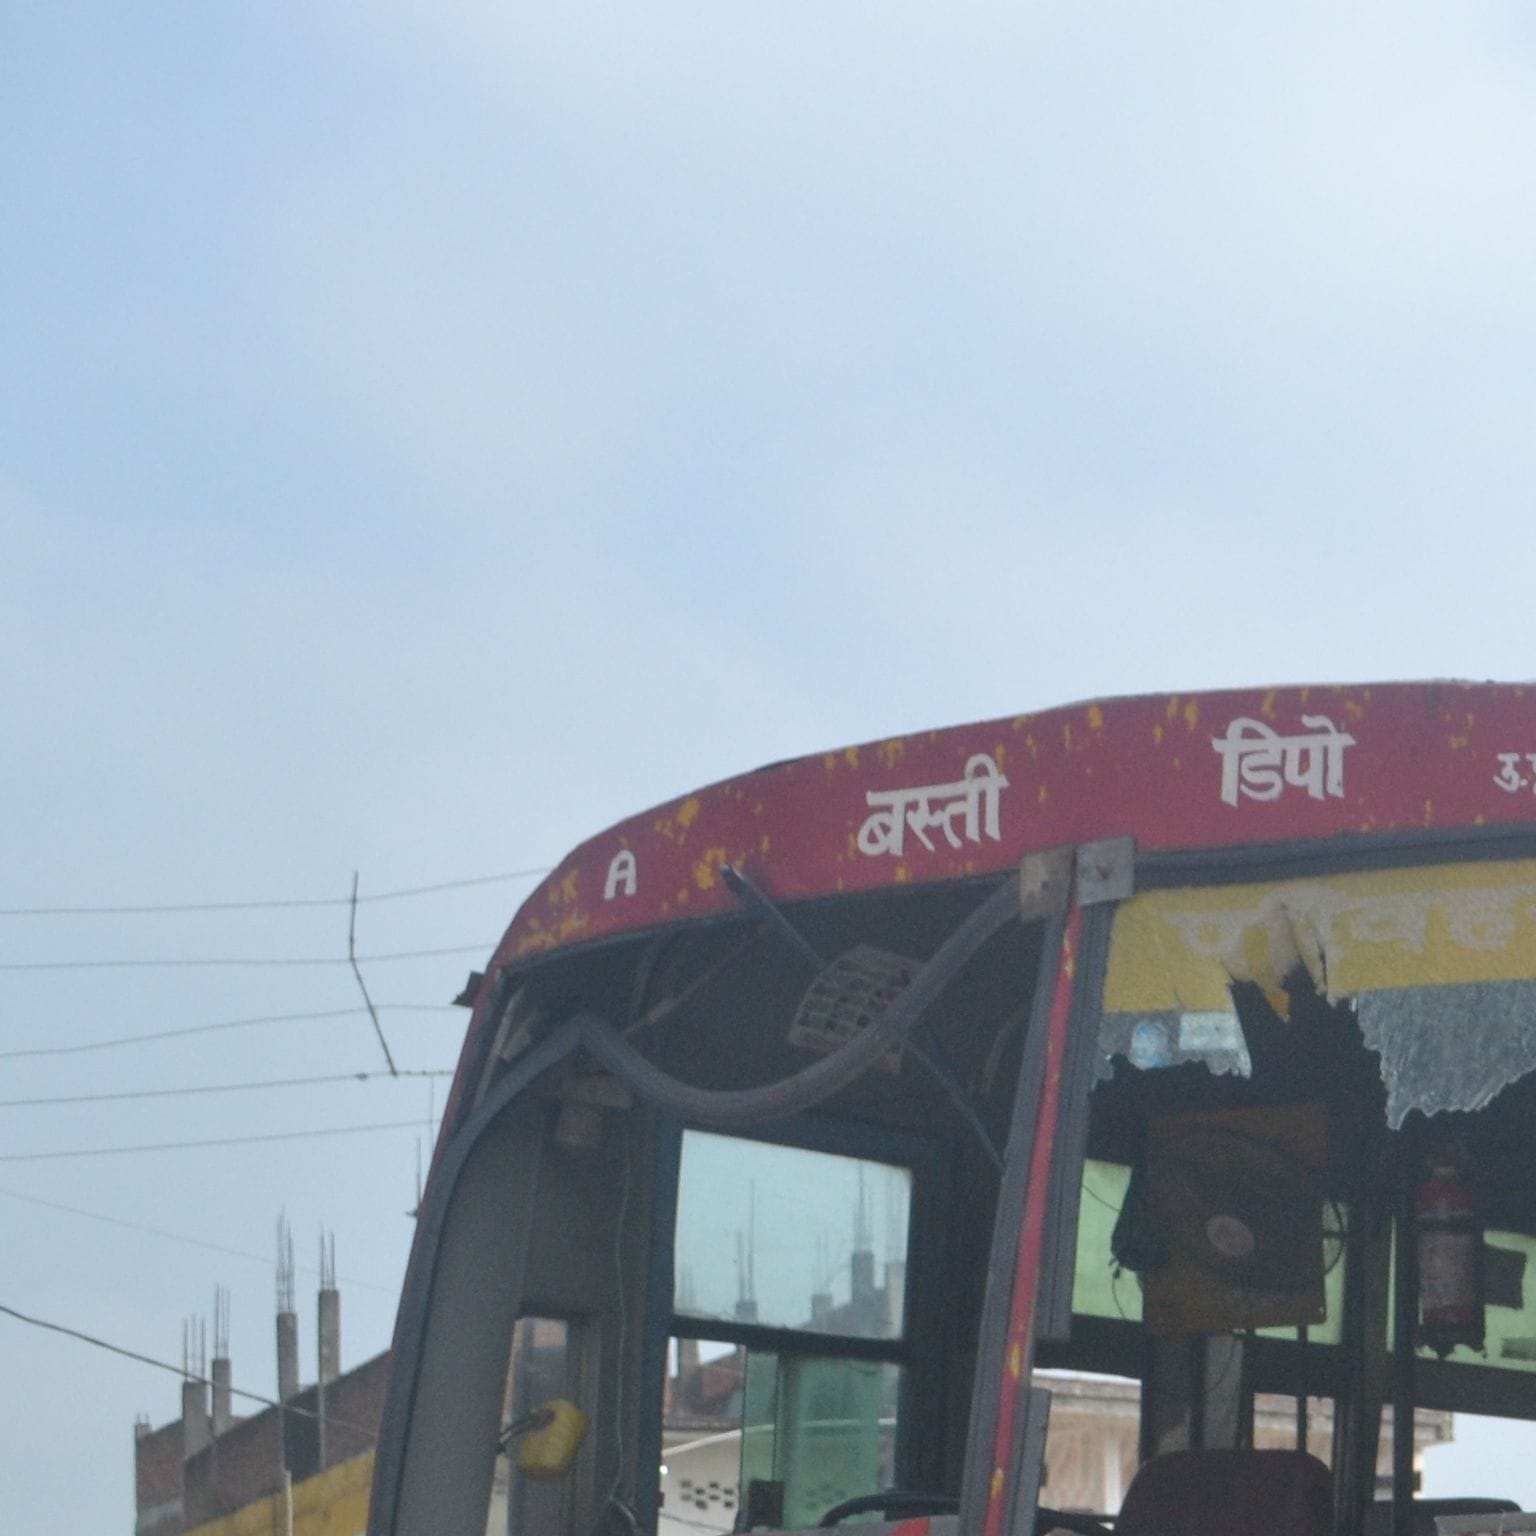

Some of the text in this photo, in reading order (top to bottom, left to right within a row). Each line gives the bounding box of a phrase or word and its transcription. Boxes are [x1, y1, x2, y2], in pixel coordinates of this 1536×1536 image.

[857, 753, 1010, 858] बस्ती
[1211, 715, 1356, 808] डिपो
[603, 849, 637, 899] A
